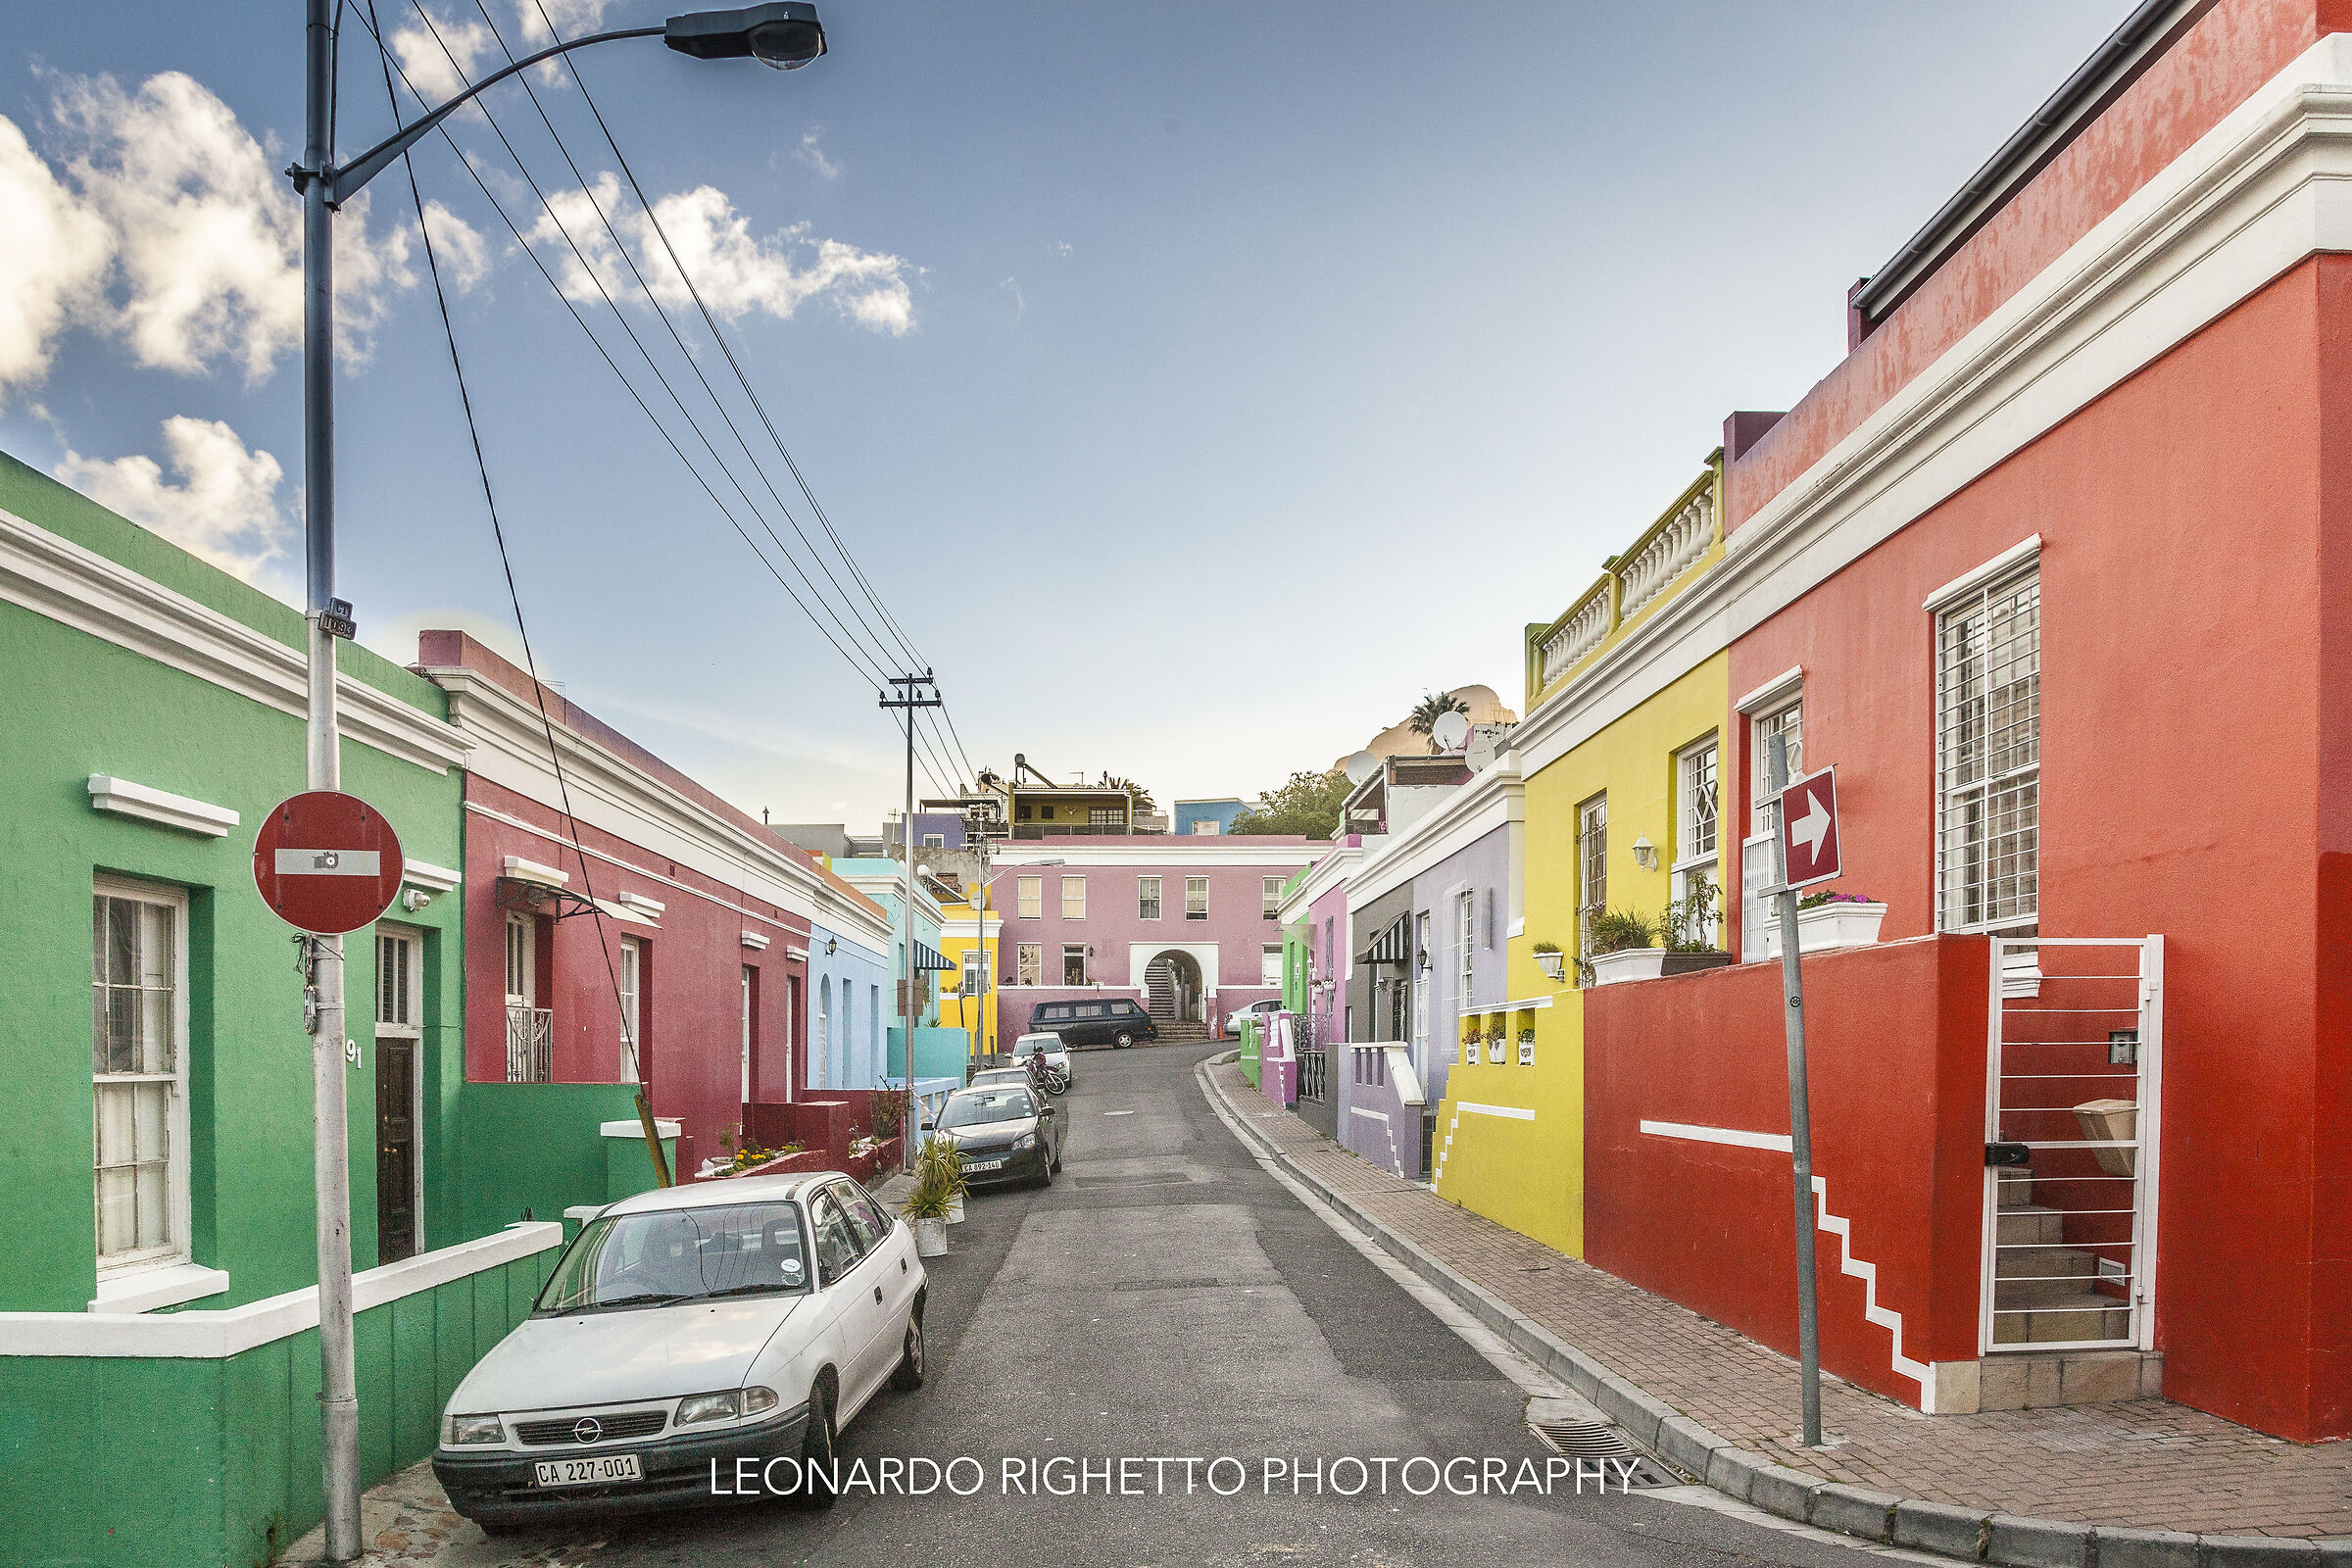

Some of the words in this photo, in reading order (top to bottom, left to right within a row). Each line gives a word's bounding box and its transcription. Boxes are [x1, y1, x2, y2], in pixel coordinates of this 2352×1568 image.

[346, 1039, 362, 1069] 91
[538, 1464, 561, 1483] CA
[565, 1457, 636, 1481] 227-001
